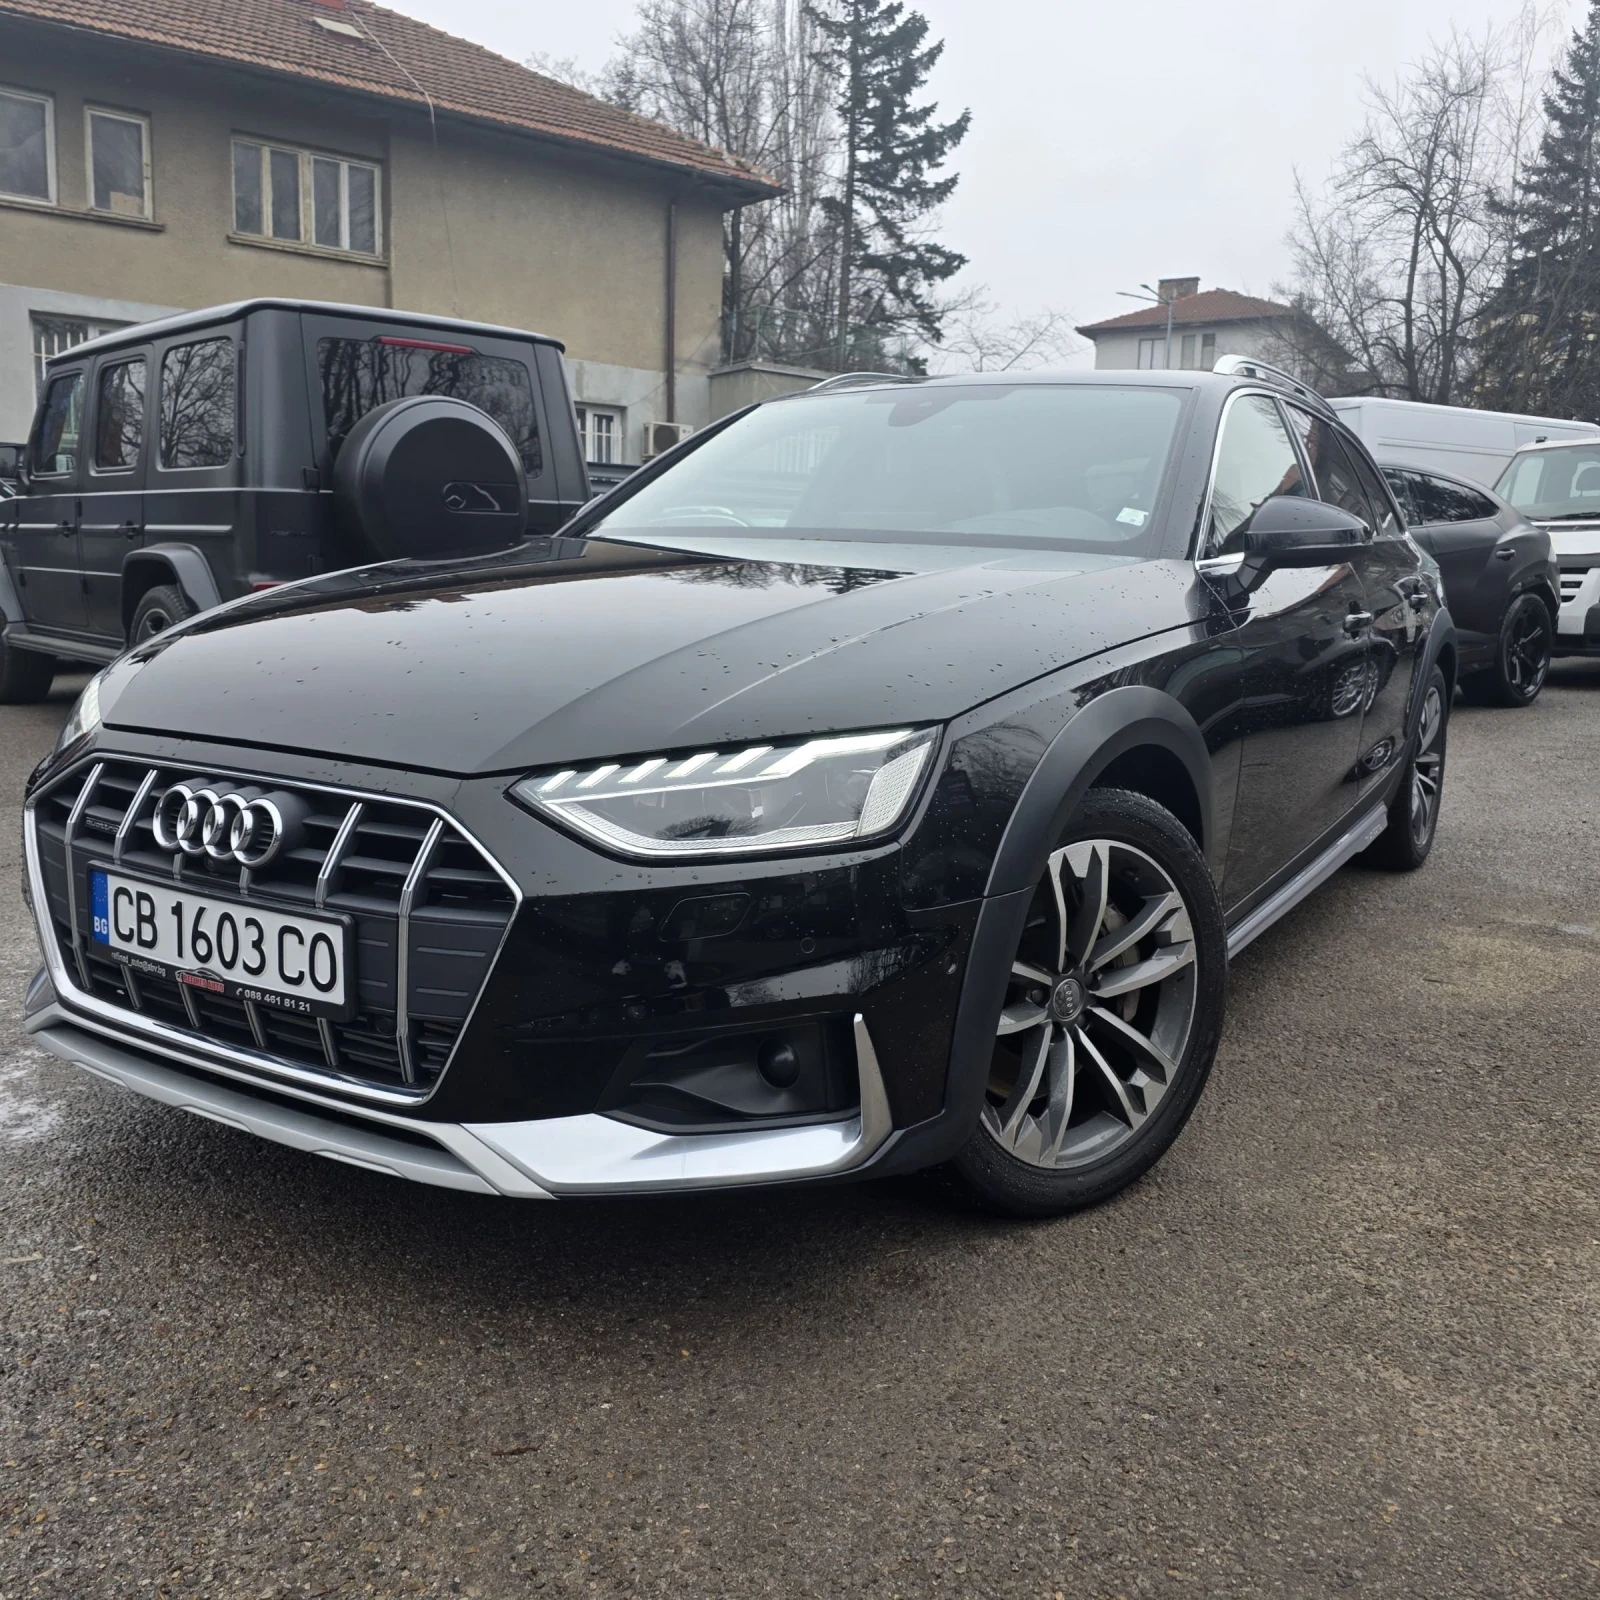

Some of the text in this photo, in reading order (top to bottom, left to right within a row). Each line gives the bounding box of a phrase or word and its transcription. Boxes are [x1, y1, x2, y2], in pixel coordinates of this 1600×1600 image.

[94, 916, 107, 934] BG
[114, 886, 158, 949] CB
[171, 900, 266, 976] 1603
[207, 979, 225, 993] AUTO
[244, 989, 311, 1012] 088 461 81 21
